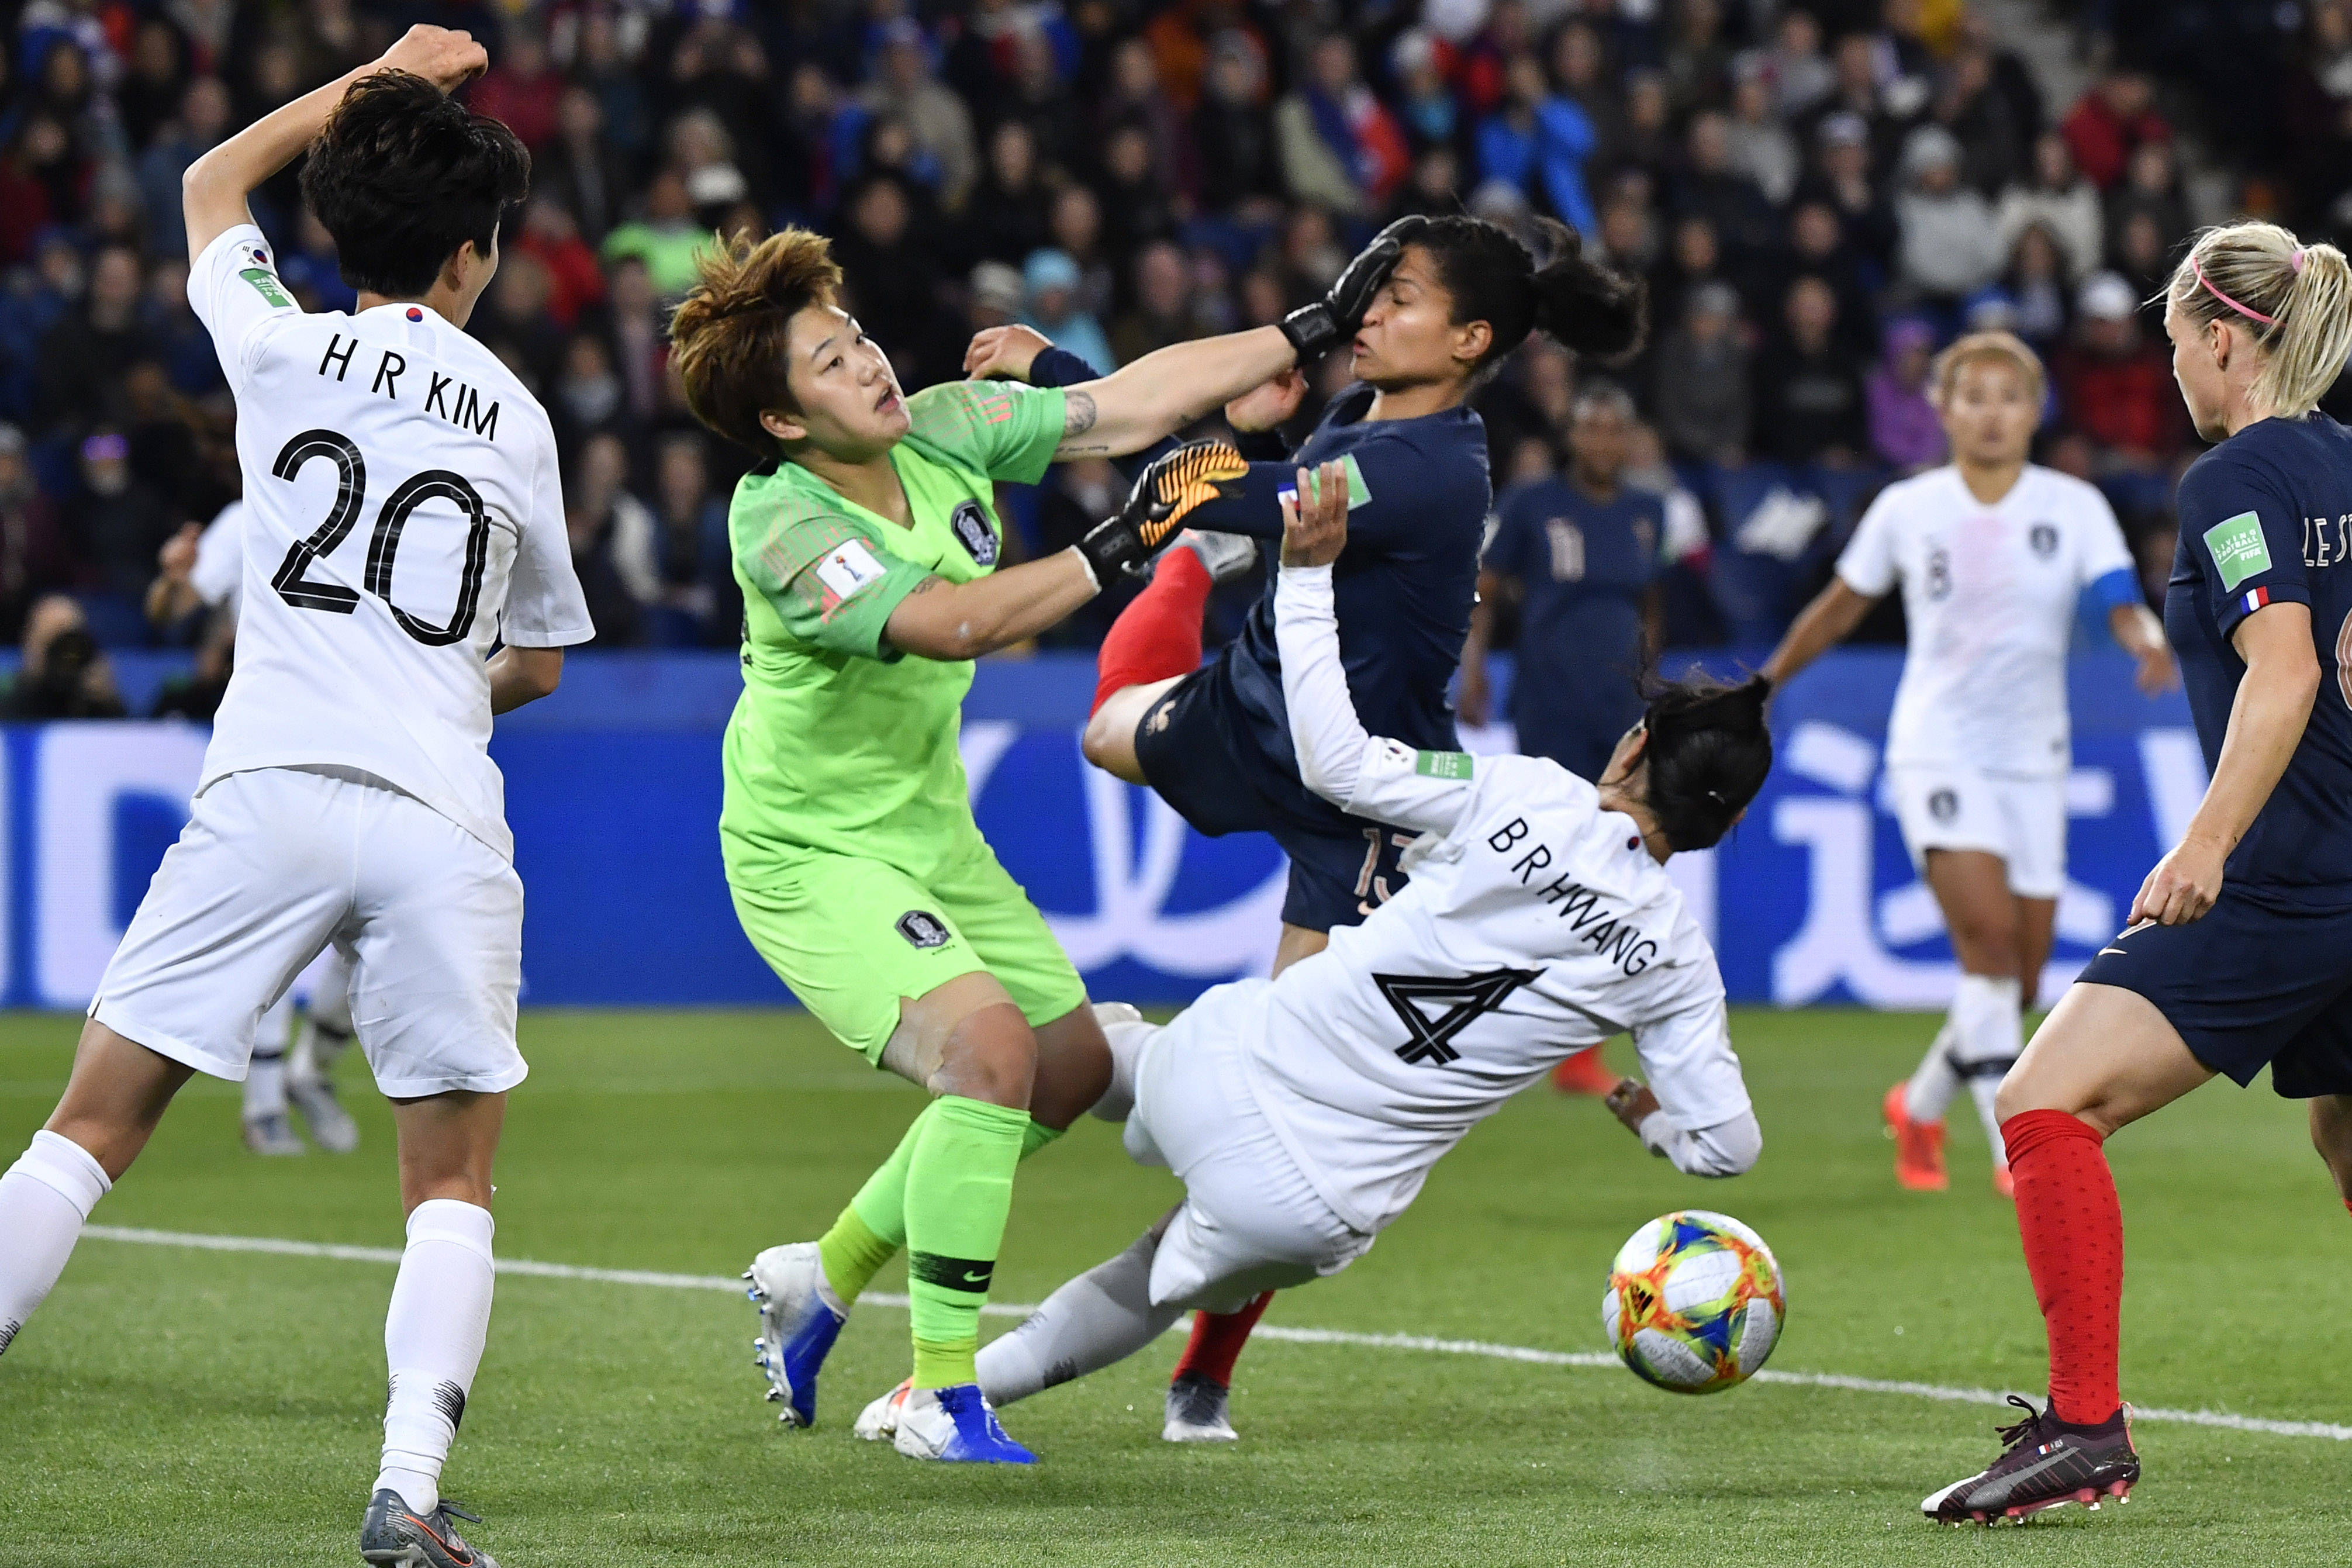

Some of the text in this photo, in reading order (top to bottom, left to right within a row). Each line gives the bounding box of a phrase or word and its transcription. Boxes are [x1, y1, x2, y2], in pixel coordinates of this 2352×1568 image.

[319, 333, 500, 441] H R KIM
[271, 429, 492, 647] 20
[2215, 529, 2257, 554] LIVING
[2240, 547, 2261, 561] FIFA
[1488, 817, 1658, 976] B R HWANG
[1371, 967, 1549, 1065] 4
